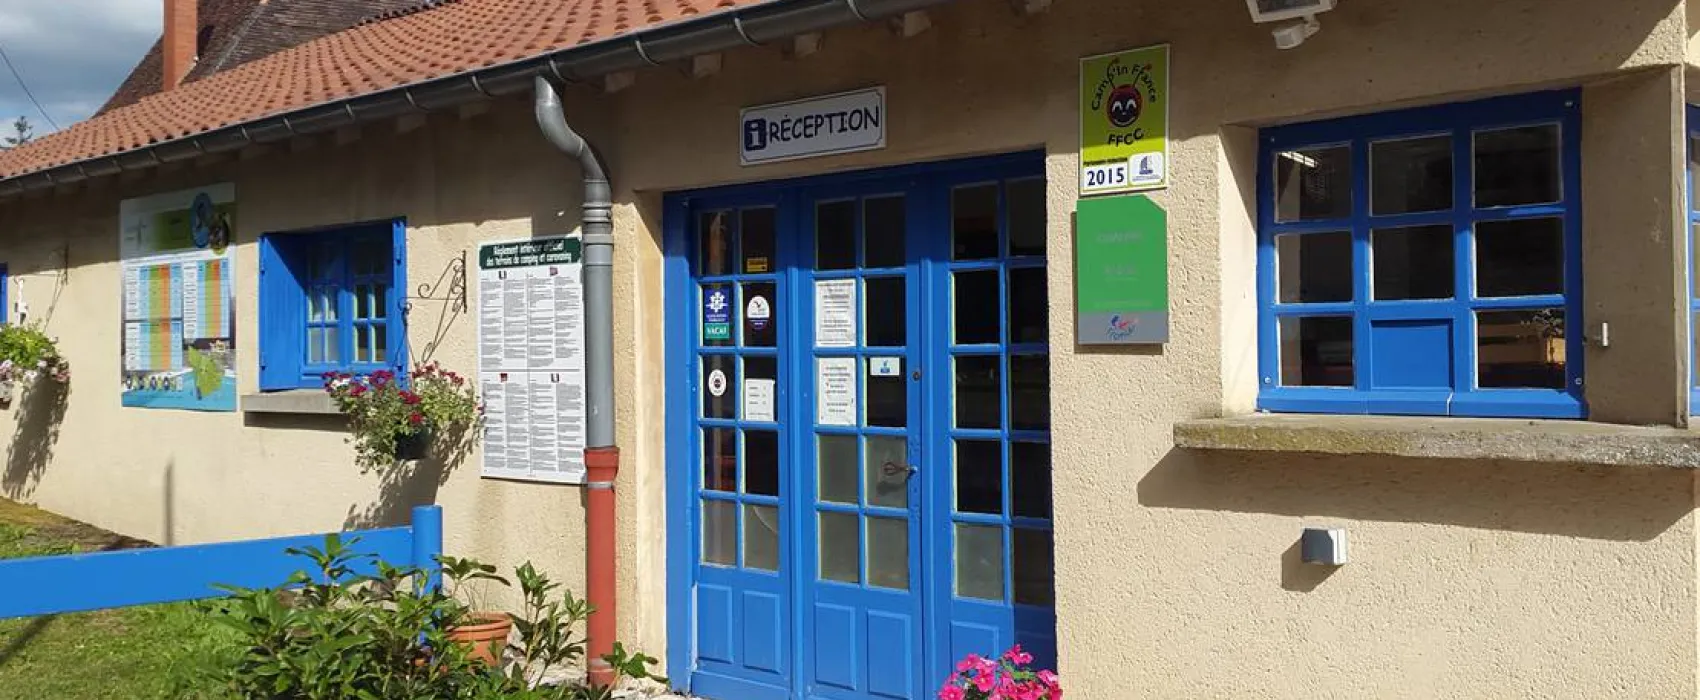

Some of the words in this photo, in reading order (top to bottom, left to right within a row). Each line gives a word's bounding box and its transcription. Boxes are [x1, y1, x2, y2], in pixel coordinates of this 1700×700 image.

[769, 105, 879, 144] RÉCEPTION
[1108, 127, 1145, 147] FFCC
[1086, 167, 1125, 186] 2015
